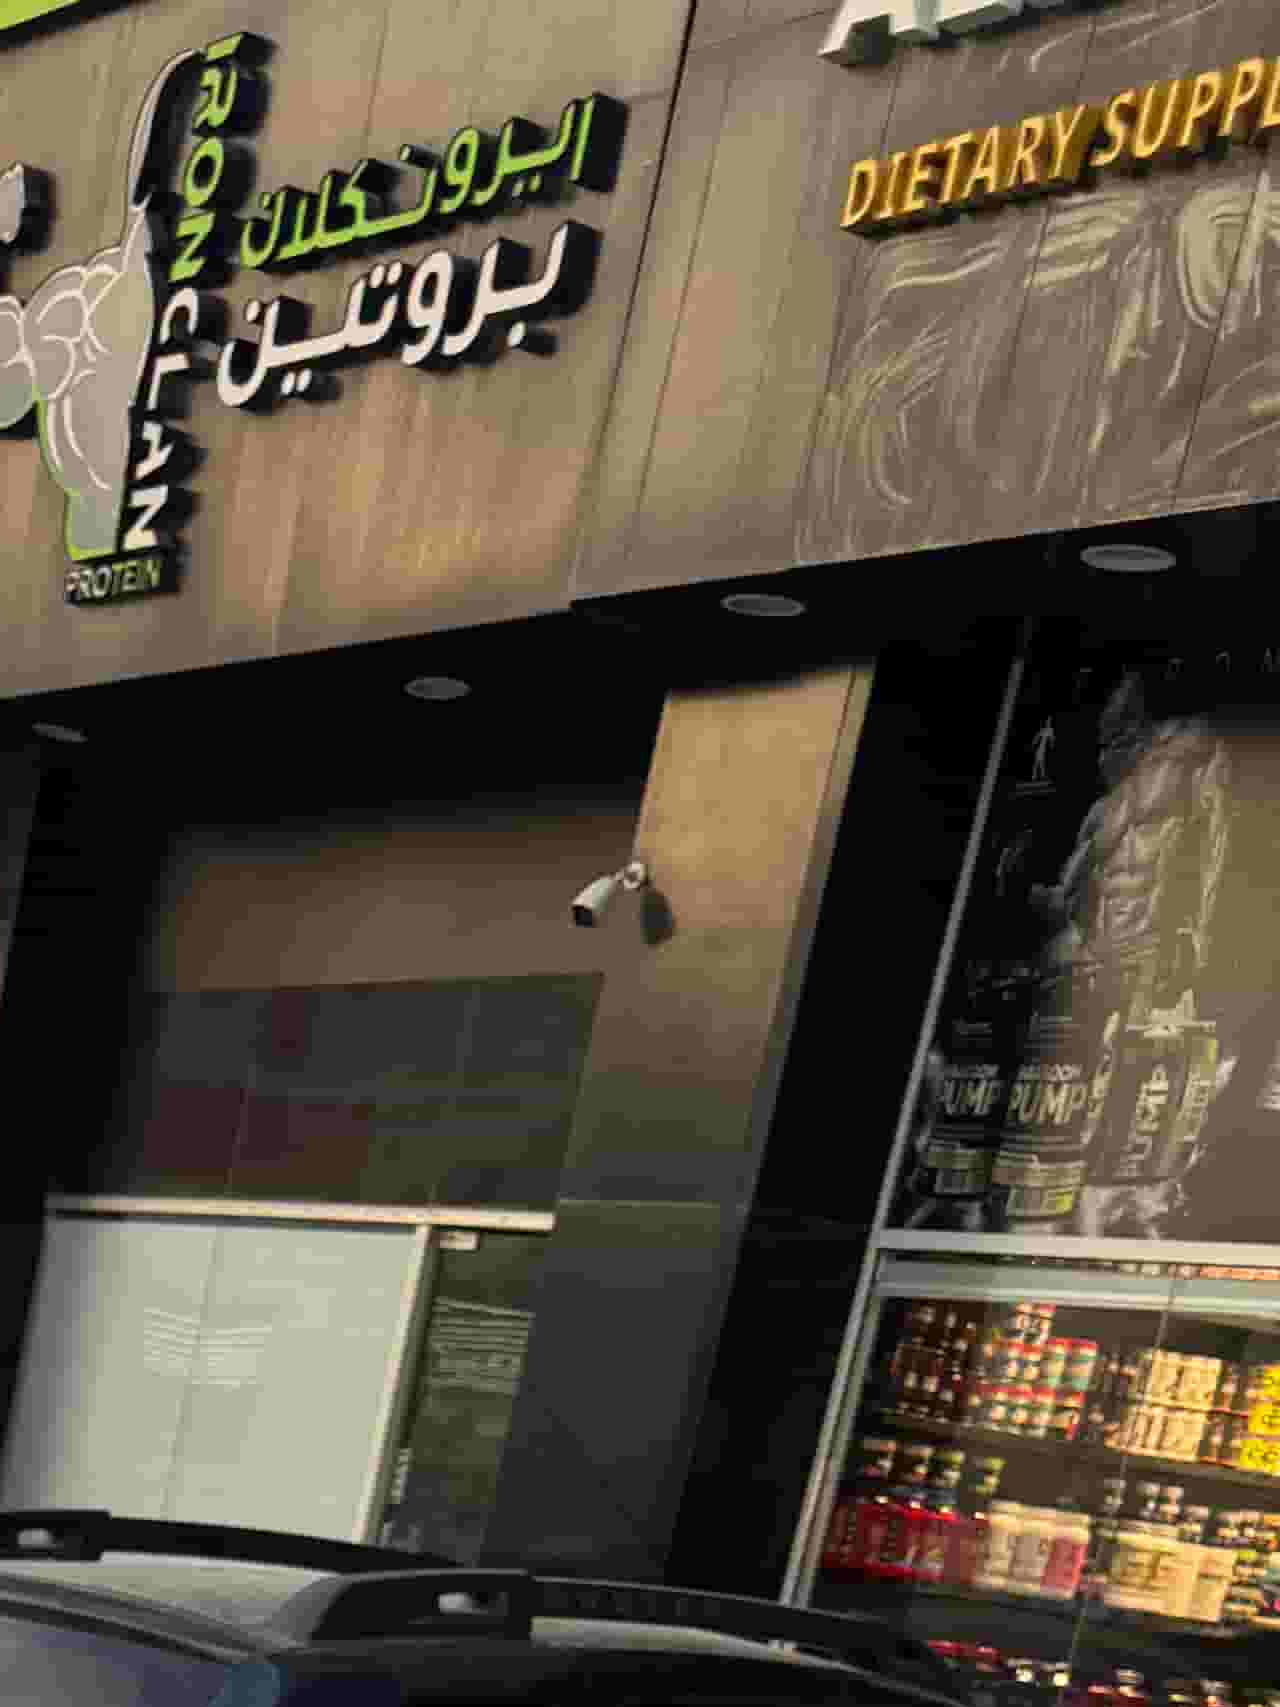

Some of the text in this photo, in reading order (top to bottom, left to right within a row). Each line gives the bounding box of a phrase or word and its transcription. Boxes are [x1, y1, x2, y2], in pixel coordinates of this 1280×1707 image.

[840, 104, 1086, 231] DIETARY
[123, 30, 242, 551] IRON CLAN
[217, 222, 570, 407] بروتين
[64, 558, 161, 602] PROTEIN
